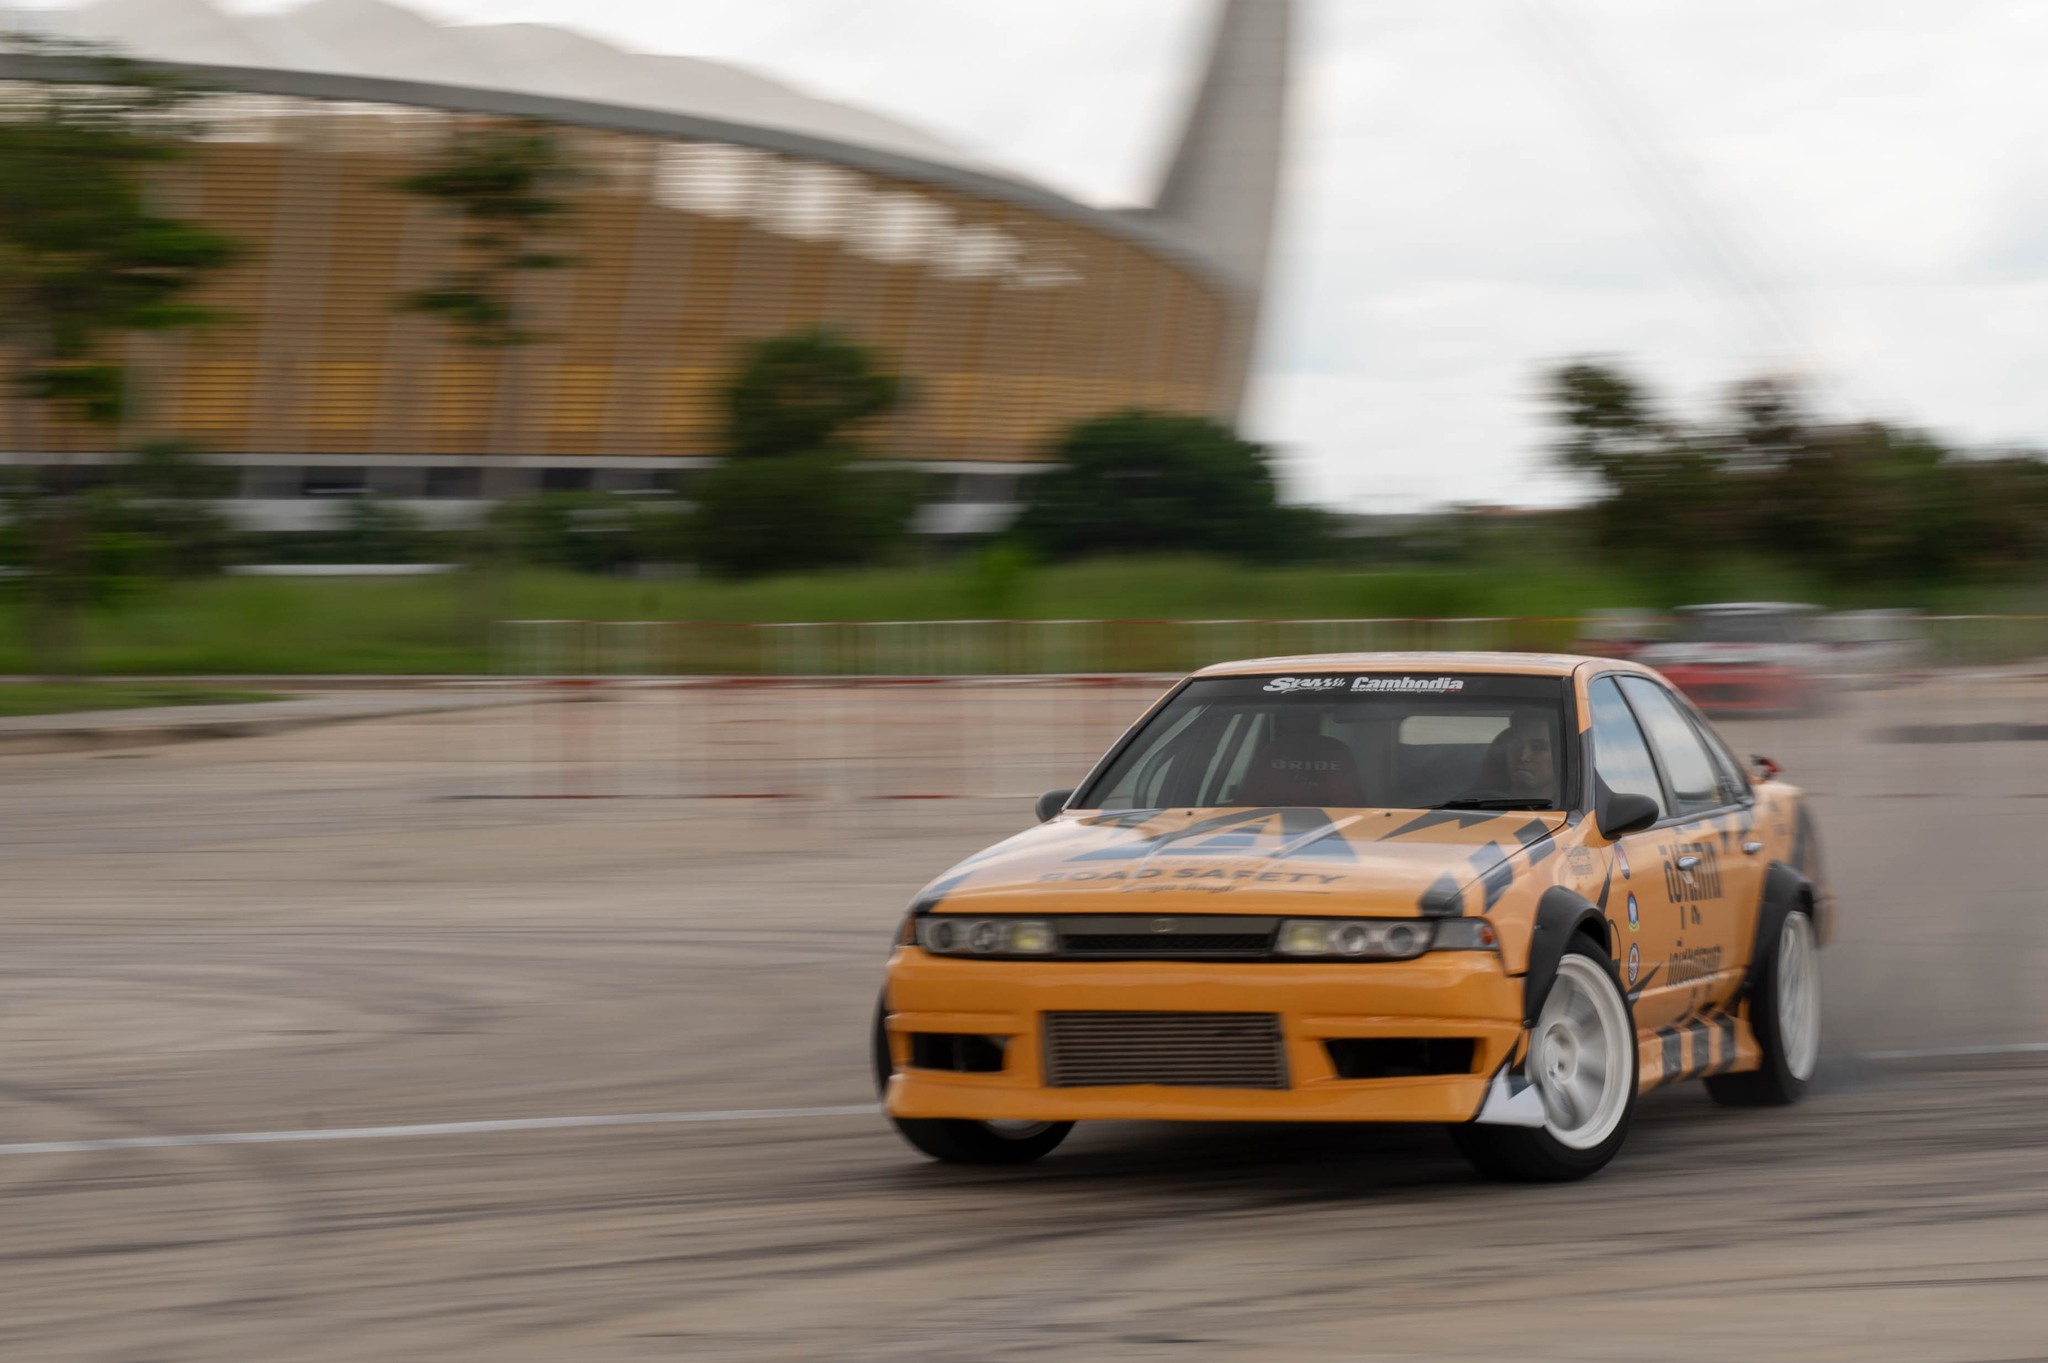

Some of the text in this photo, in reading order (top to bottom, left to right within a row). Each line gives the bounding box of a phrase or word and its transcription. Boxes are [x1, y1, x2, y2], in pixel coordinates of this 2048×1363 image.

[1352, 677, 1464, 689] Cambodia
[1271, 760, 1342, 771] BRIDE
[1038, 868, 1348, 884] ROAD SAFETY
